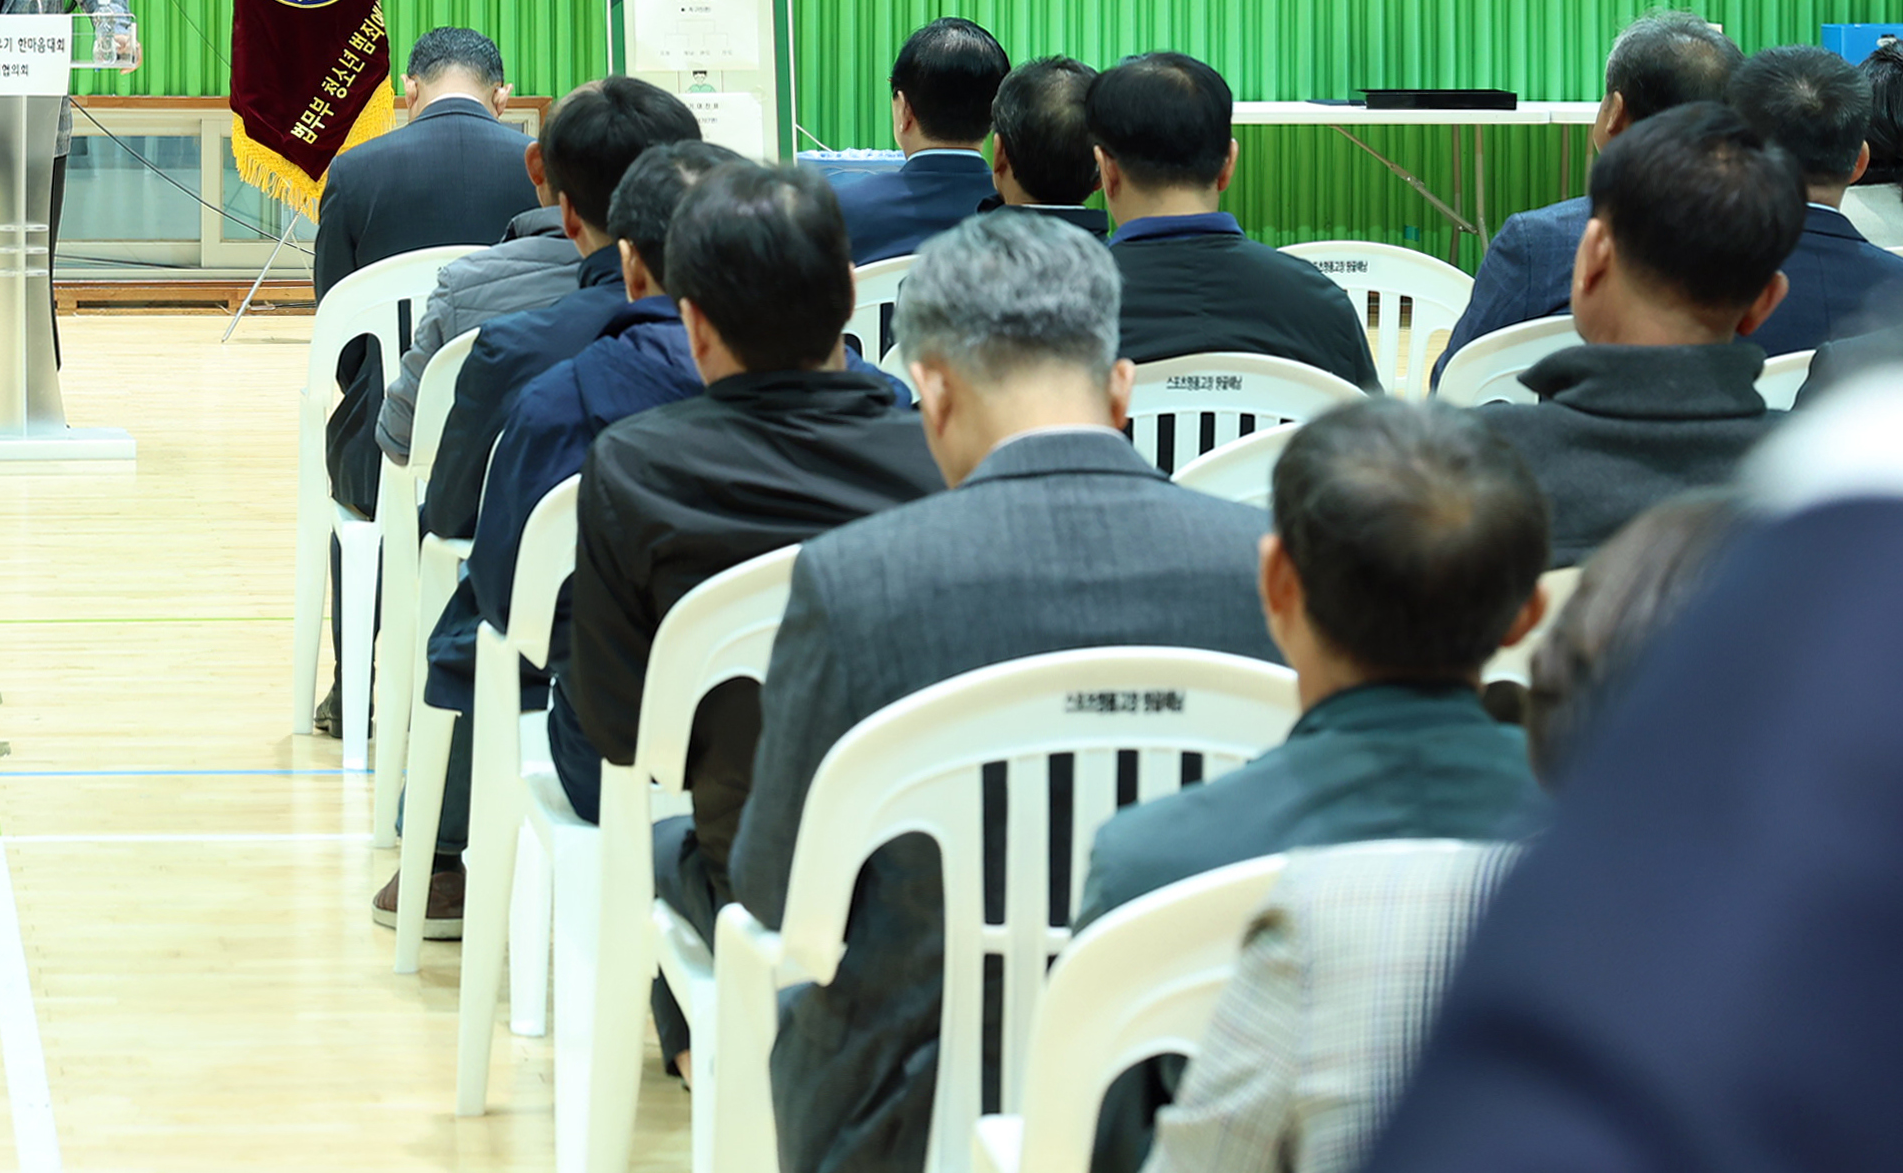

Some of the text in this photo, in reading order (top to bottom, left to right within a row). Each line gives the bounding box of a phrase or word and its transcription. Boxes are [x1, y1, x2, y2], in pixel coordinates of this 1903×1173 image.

[17, 37, 65, 53] 한마음대회
[290, 96, 334, 144] 법무부
[321, 48, 366, 99] 청소년
